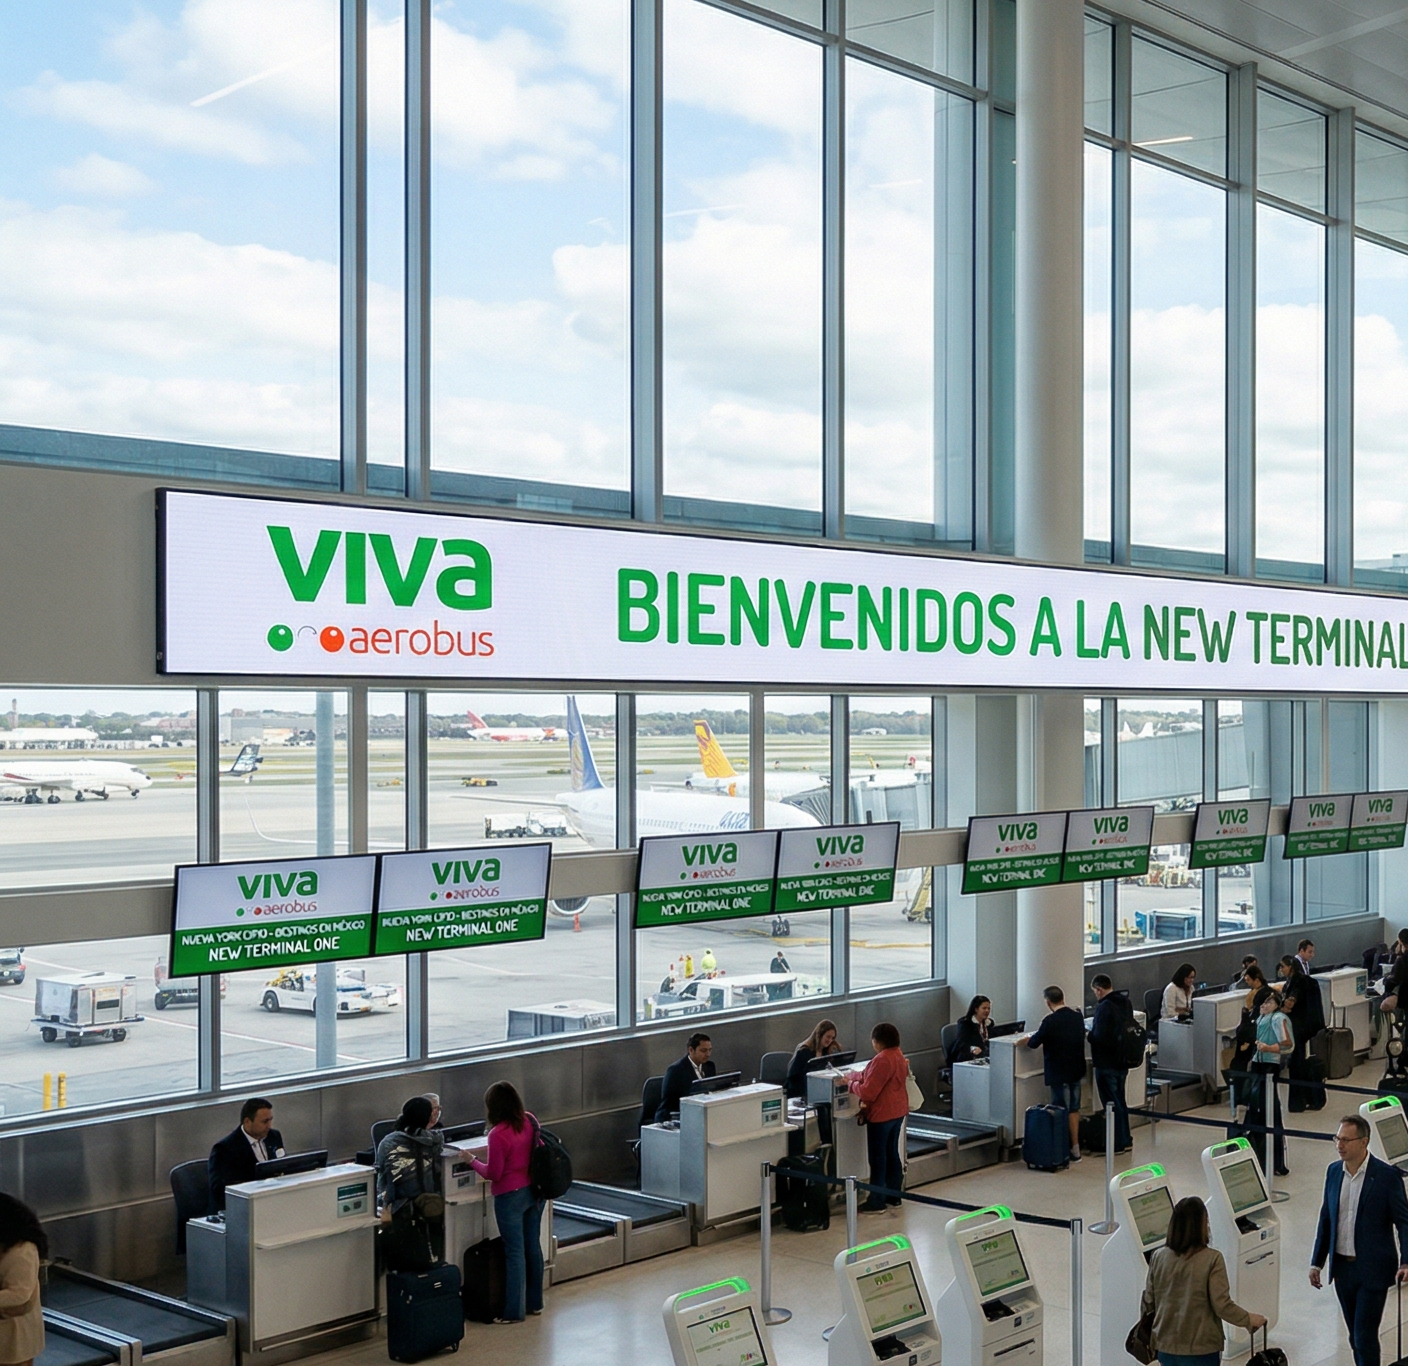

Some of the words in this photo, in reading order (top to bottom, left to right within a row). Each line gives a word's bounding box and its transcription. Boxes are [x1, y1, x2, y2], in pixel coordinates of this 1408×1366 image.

[617, 567, 1017, 656] BIENVENIDOS
[1029, 596, 1062, 658] A
[1076, 599, 1131, 660] LA
[1143, 604, 1237, 664] NEW
[350, 619, 496, 658] aerobus
[406, 927, 436, 942] NEW
[495, 918, 519, 932] ONE
[208, 945, 243, 962] NEW
[244, 939, 312, 958] TERMINAL
[314, 935, 341, 951] ONE
